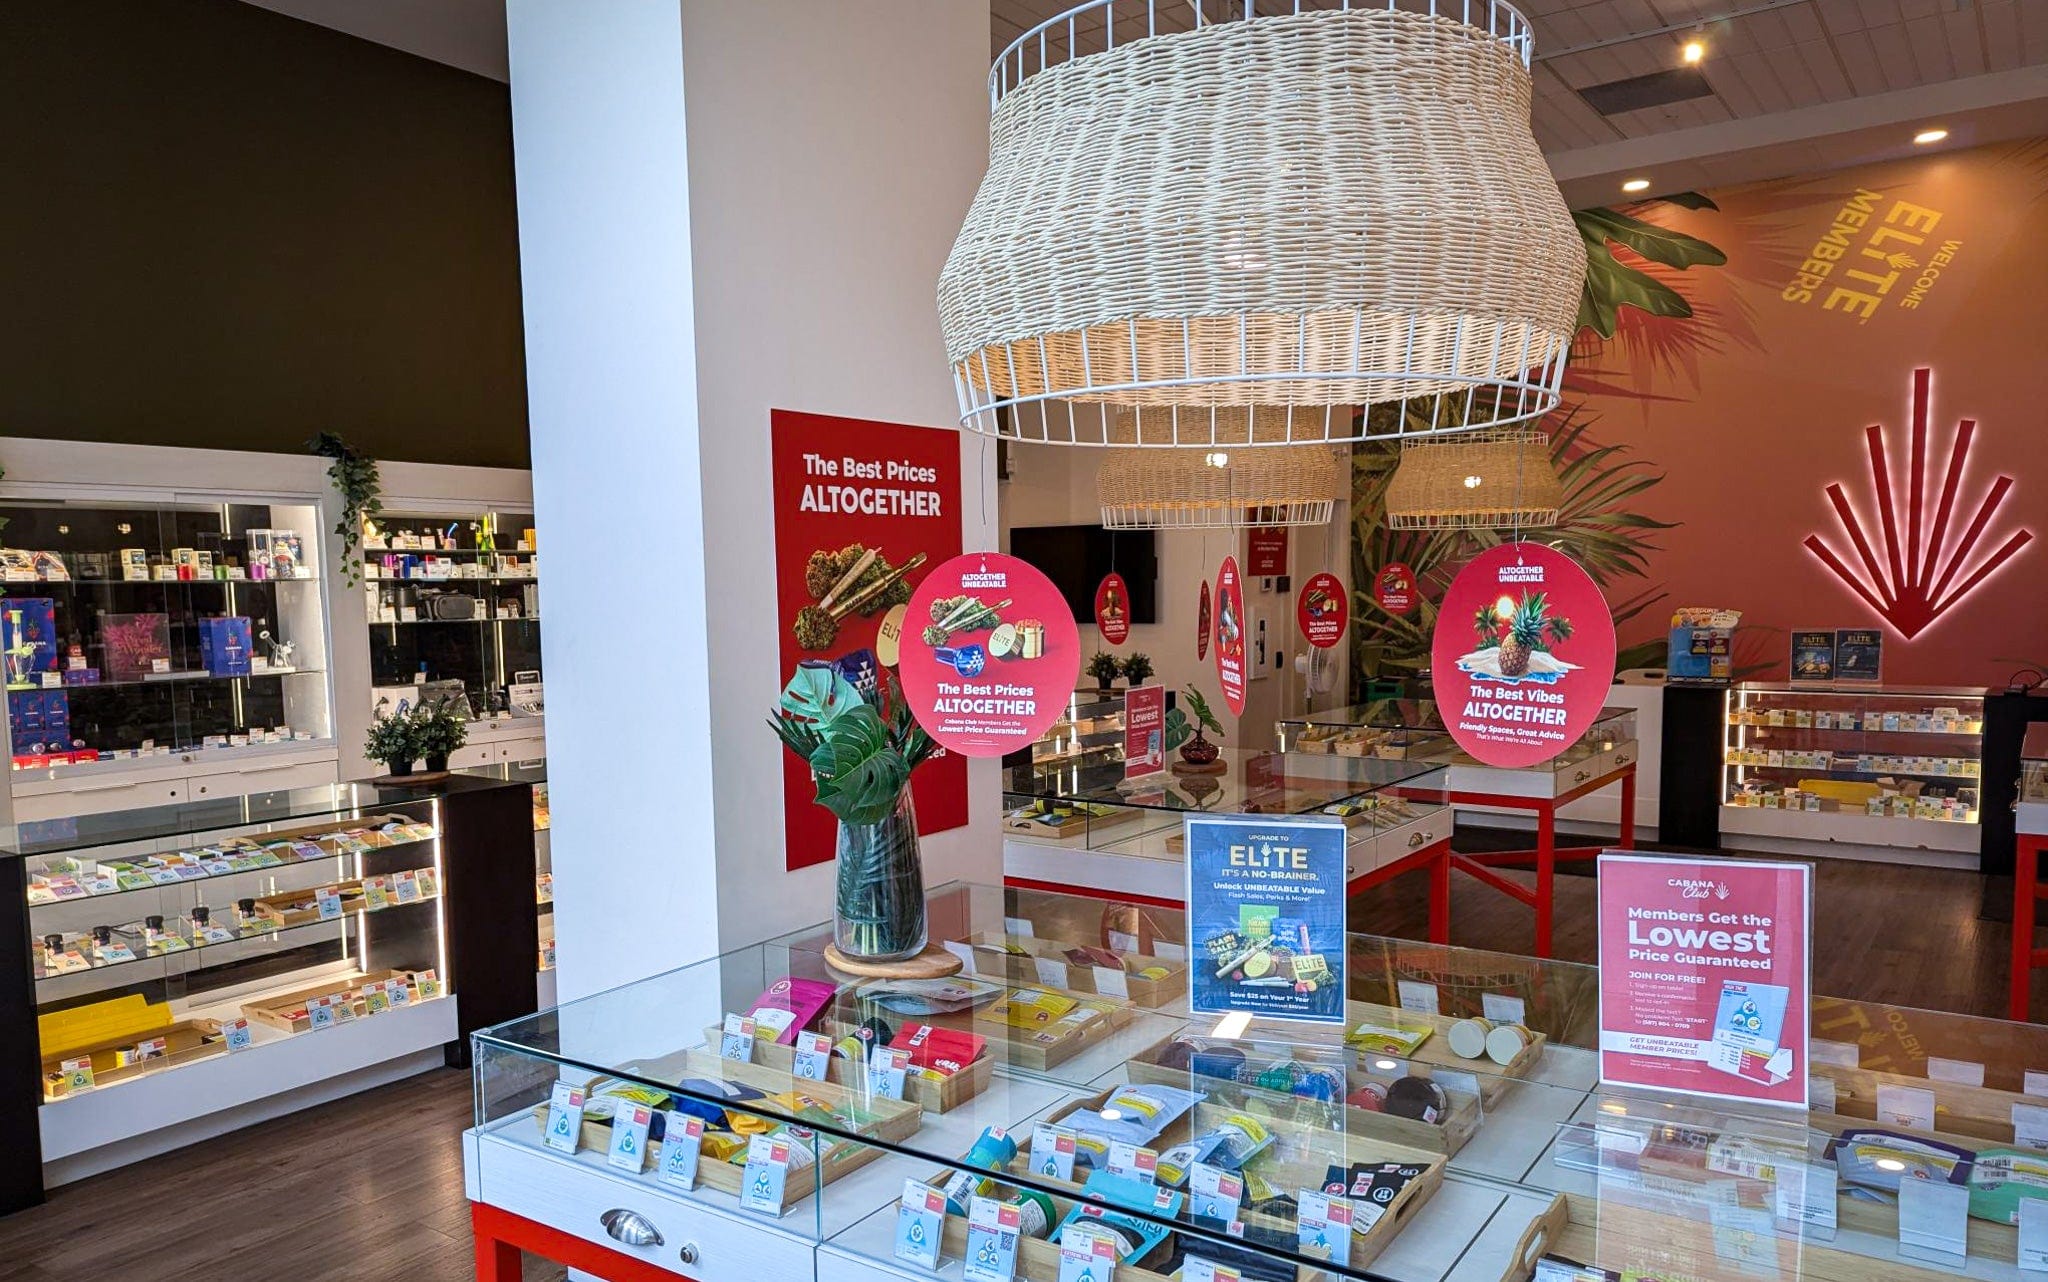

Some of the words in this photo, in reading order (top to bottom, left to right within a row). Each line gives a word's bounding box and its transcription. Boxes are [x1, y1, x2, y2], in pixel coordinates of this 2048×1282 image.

[1781, 188, 1884, 304] MEMBERS
[1900, 239, 1963, 310] WELCOME
[803, 453, 838, 477] The
[842, 457, 883, 481] Best
[886, 461, 937, 483] Prices
[800, 484, 942, 517] ALTOGETHER
[961, 573, 1007, 581] ALTOGETHER
[1498, 566, 1544, 575] ALTOGETHER
[961, 580, 1007, 588] UNBEATABLE
[1498, 574, 1545, 583] UNBEATABLE
[881, 622, 901, 642] ELIT
[937, 683, 960, 695] The
[963, 684, 991, 696] Best
[994, 685, 1034, 697] Prices
[1470, 685, 1493, 698] The
[1495, 687, 1524, 701] Best
[1527, 688, 1564, 704] Vibes
[933, 698, 1036, 715] ALTOGETHER
[1131, 710, 1159, 723] Lowest
[1463, 701, 1567, 726] ALTOGETHER
[938, 725, 964, 733] Lowest
[984, 726, 1027, 735] Guaranteed
[1459, 721, 1488, 733] Friendly
[1488, 725, 1516, 736] Spaces,
[1516, 728, 1537, 736] Great
[1539, 730, 1565, 740] Advice
[1222, 869, 1239, 877] IT'S
[1251, 870, 1319, 881] NO-BRAINER.
[1214, 882, 1242, 890] Unlock
[1244, 883, 1300, 893] UNBEATABLE
[1301, 886, 1326, 895] Value
[1668, 878, 1714, 889] CABANA
[1682, 887, 1710, 899] Club
[1628, 907, 1704, 923] Members
[1708, 912, 1738, 925] Get
[1742, 914, 1772, 927] the
[1628, 920, 1771, 954] Lowest
[1629, 949, 1669, 962] Price
[1674, 952, 1772, 970] Guaranteed
[1629, 971, 1652, 980] JOIN
[1655, 973, 1675, 981] FOR
[1677, 975, 1706, 984] FREE!
[1629, 1043, 1664, 1052] MEMBER
[1666, 1047, 1698, 1056] PRICES!
[1647, 1039, 1699, 1049] UNBEATABLE
